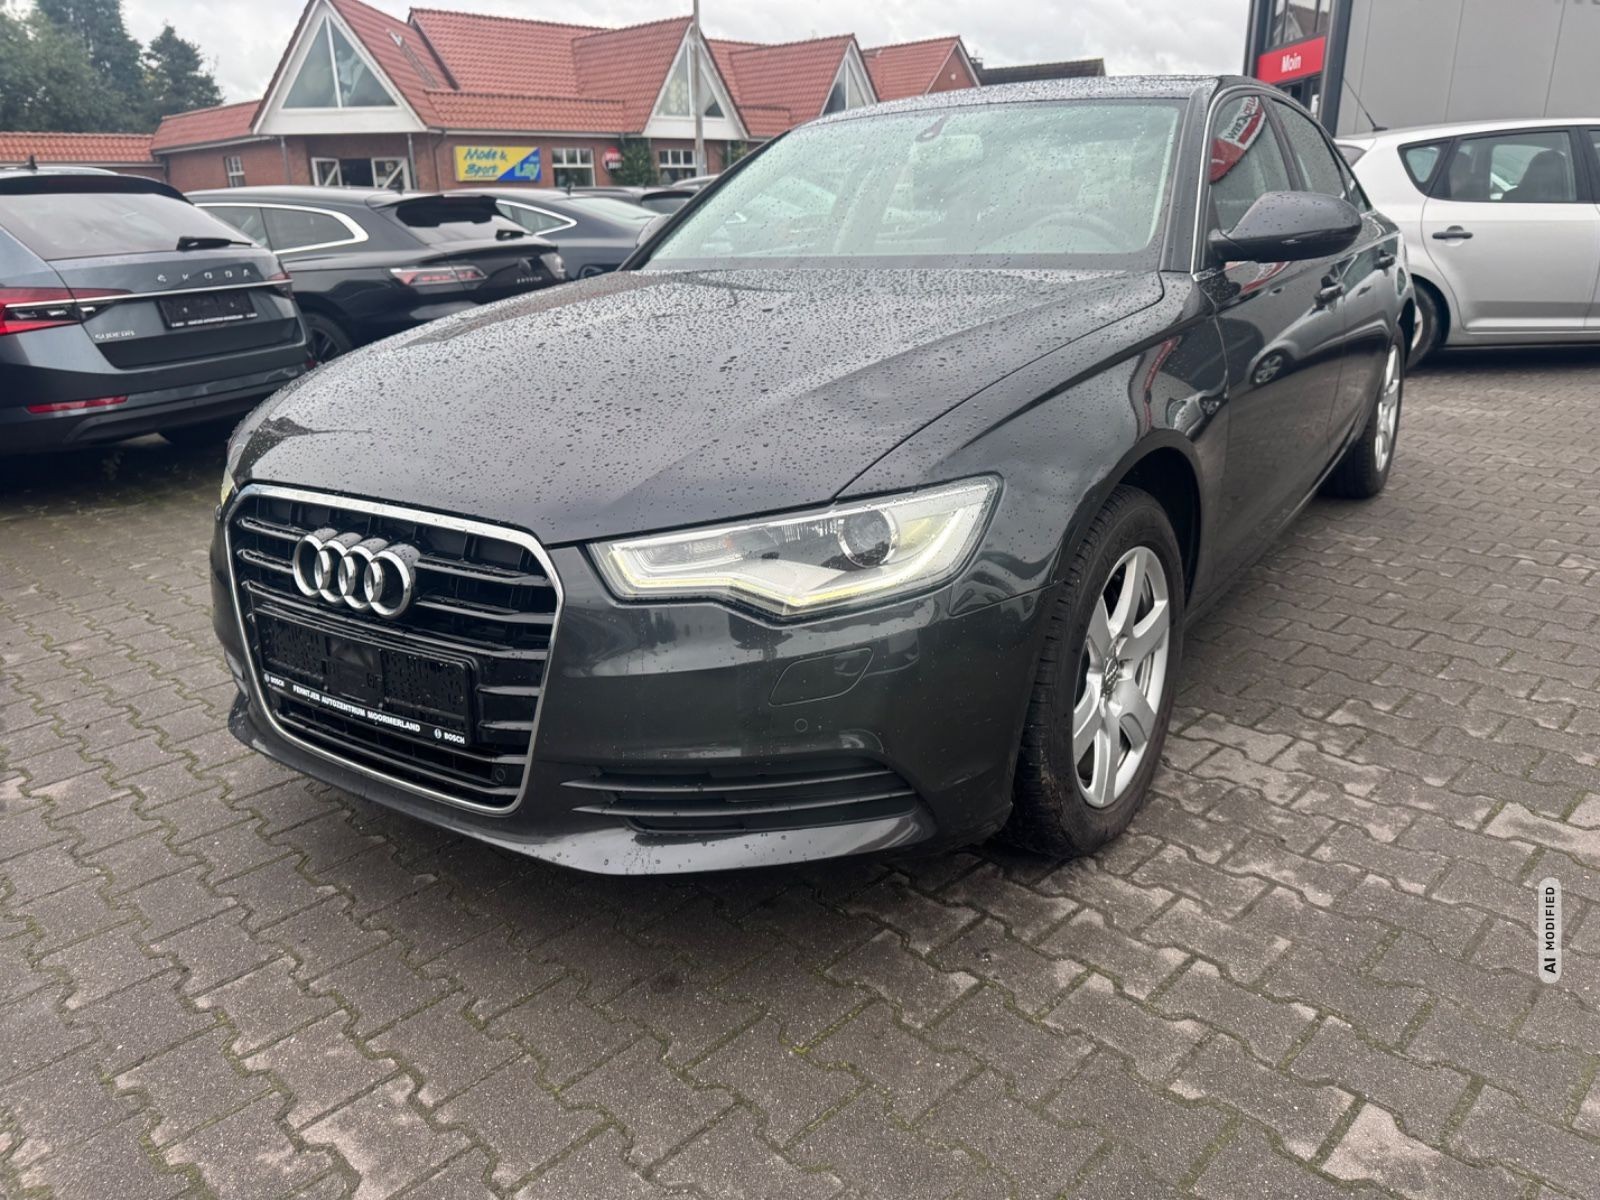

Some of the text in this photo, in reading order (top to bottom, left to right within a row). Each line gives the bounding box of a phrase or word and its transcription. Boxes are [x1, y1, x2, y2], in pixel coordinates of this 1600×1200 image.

[1280, 52, 1302, 73] Moin
[464, 147, 498, 160] Mode
[464, 163, 499, 177] Sport
[321, 695, 366, 717] AUTOZENTRUM
[366, 711, 421, 733] MOORMERLAND
[443, 732, 466, 745] BOSCH
